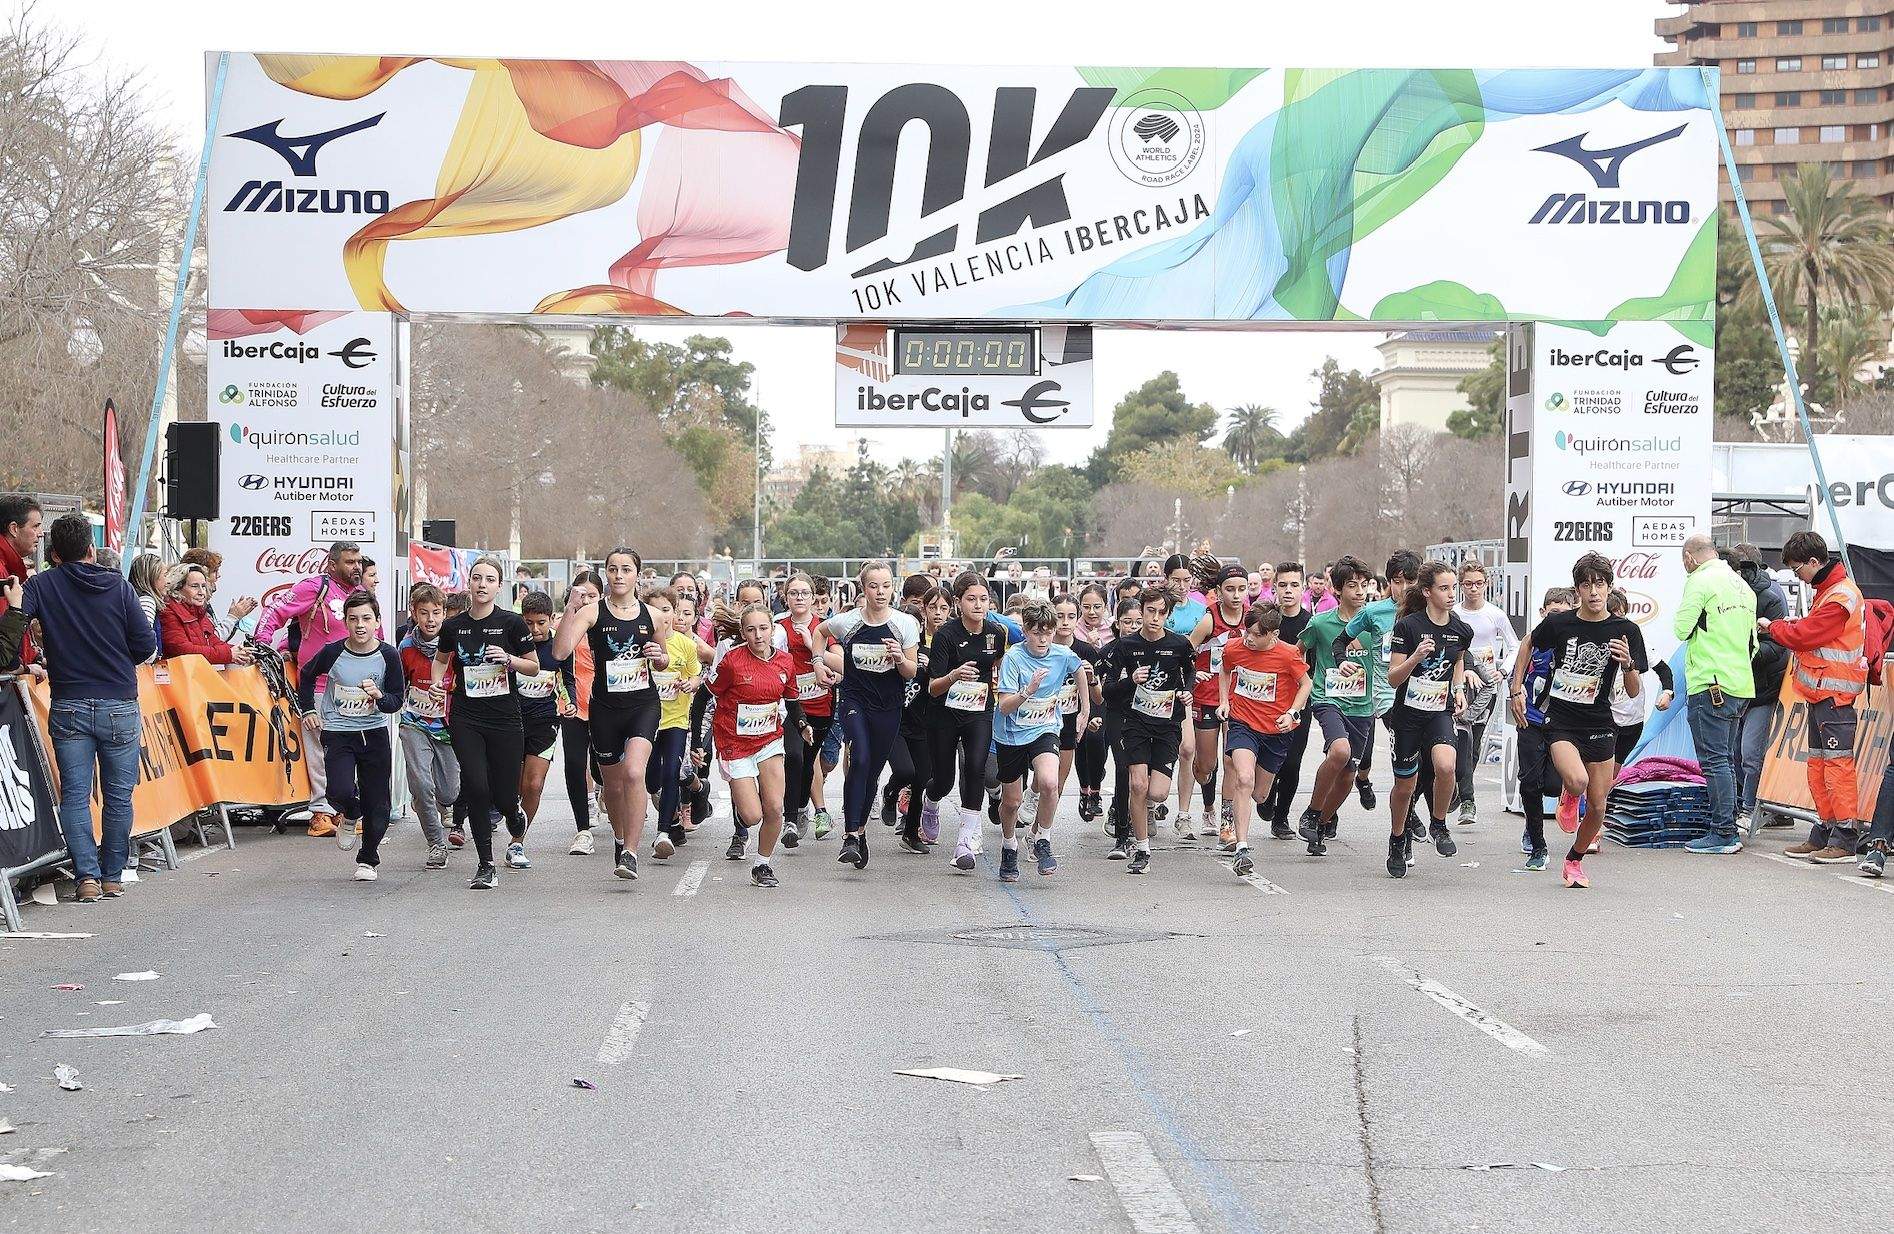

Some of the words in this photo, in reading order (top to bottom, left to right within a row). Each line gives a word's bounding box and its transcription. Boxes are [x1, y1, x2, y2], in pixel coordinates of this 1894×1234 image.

[1141, 175, 1164, 183] ROAD
[1165, 168, 1185, 181] RACE
[1184, 146, 1200, 170] LABEL
[1193, 124, 1201, 144] 2024
[778, 82, 1118, 278] 10K
[851, 278, 902, 314] 10K
[911, 238, 1054, 298] VALENCIA
[1064, 193, 1211, 255] IBERCAJA
[223, 340, 319, 364] iberCaja
[904, 339, 1025, 369] 0:00:00
[1550, 349, 1643, 371] iberCaja
[249, 389, 298, 398] TRINIDAD
[322, 383, 366, 396] Cultura
[321, 396, 377, 408] Esfuerzo
[857, 386, 990, 417] iberCaja
[1573, 397, 1621, 405] TRINIDAD
[1645, 390, 1688, 402] Cultura
[249, 399, 298, 407] ALFONSO
[1644, 402, 1699, 414] Esfuerzo
[1573, 406, 1621, 414] ALFONSO
[249, 430, 359, 449] quirónsalud
[1573, 436, 1681, 456] quirónsalud
[266, 454, 320, 464] Healthcare
[322, 454, 359, 464] Partner
[1590, 460, 1642, 470] Healthcare
[1644, 461, 1680, 470] Partner
[274, 476, 354, 489] HYUNDAI
[1597, 482, 1674, 494] HYUNDAI
[274, 491, 316, 501] Autiber
[319, 492, 353, 502] Motor
[1597, 497, 1638, 507] Autiber
[1640, 497, 1674, 507] Motor
[230, 516, 292, 537] 226ERS
[321, 517, 366, 526] AEDAS
[1642, 522, 1686, 531] AEDAS
[321, 528, 365, 536] HOMES
[1554, 521, 1614, 542] 226ERS
[1642, 533, 1685, 541] HOMES
